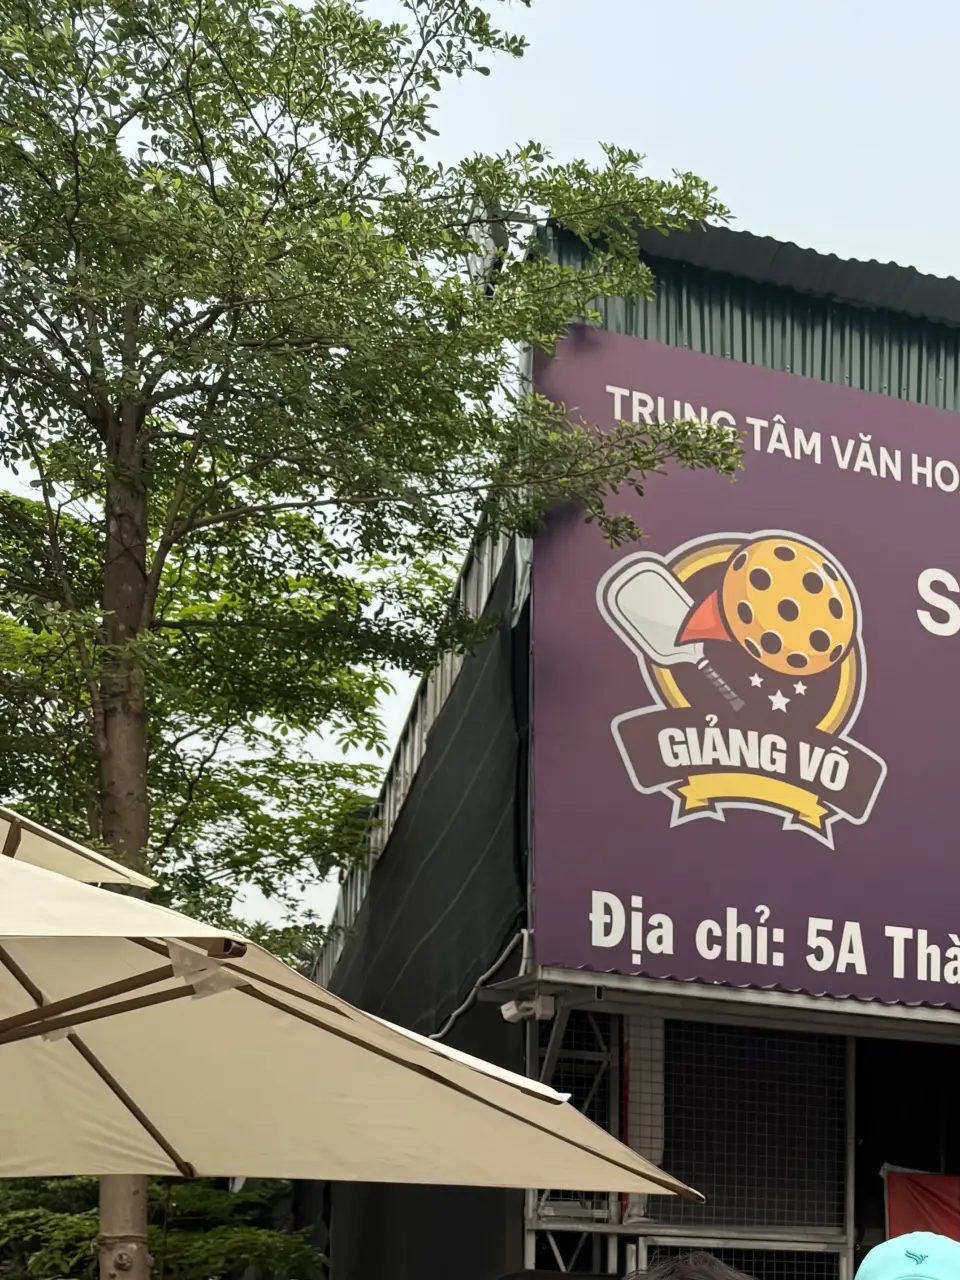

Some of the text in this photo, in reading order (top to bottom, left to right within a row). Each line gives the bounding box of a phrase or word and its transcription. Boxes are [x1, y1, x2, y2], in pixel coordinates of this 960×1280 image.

[746, 415, 822, 465] TÂM
[831, 432, 902, 482] VĂN
[657, 714, 849, 792] GIẢNG VÕ
[588, 890, 674, 965] Địa
[695, 905, 786, 967] chỉ:
[805, 917, 869, 976] 5A
